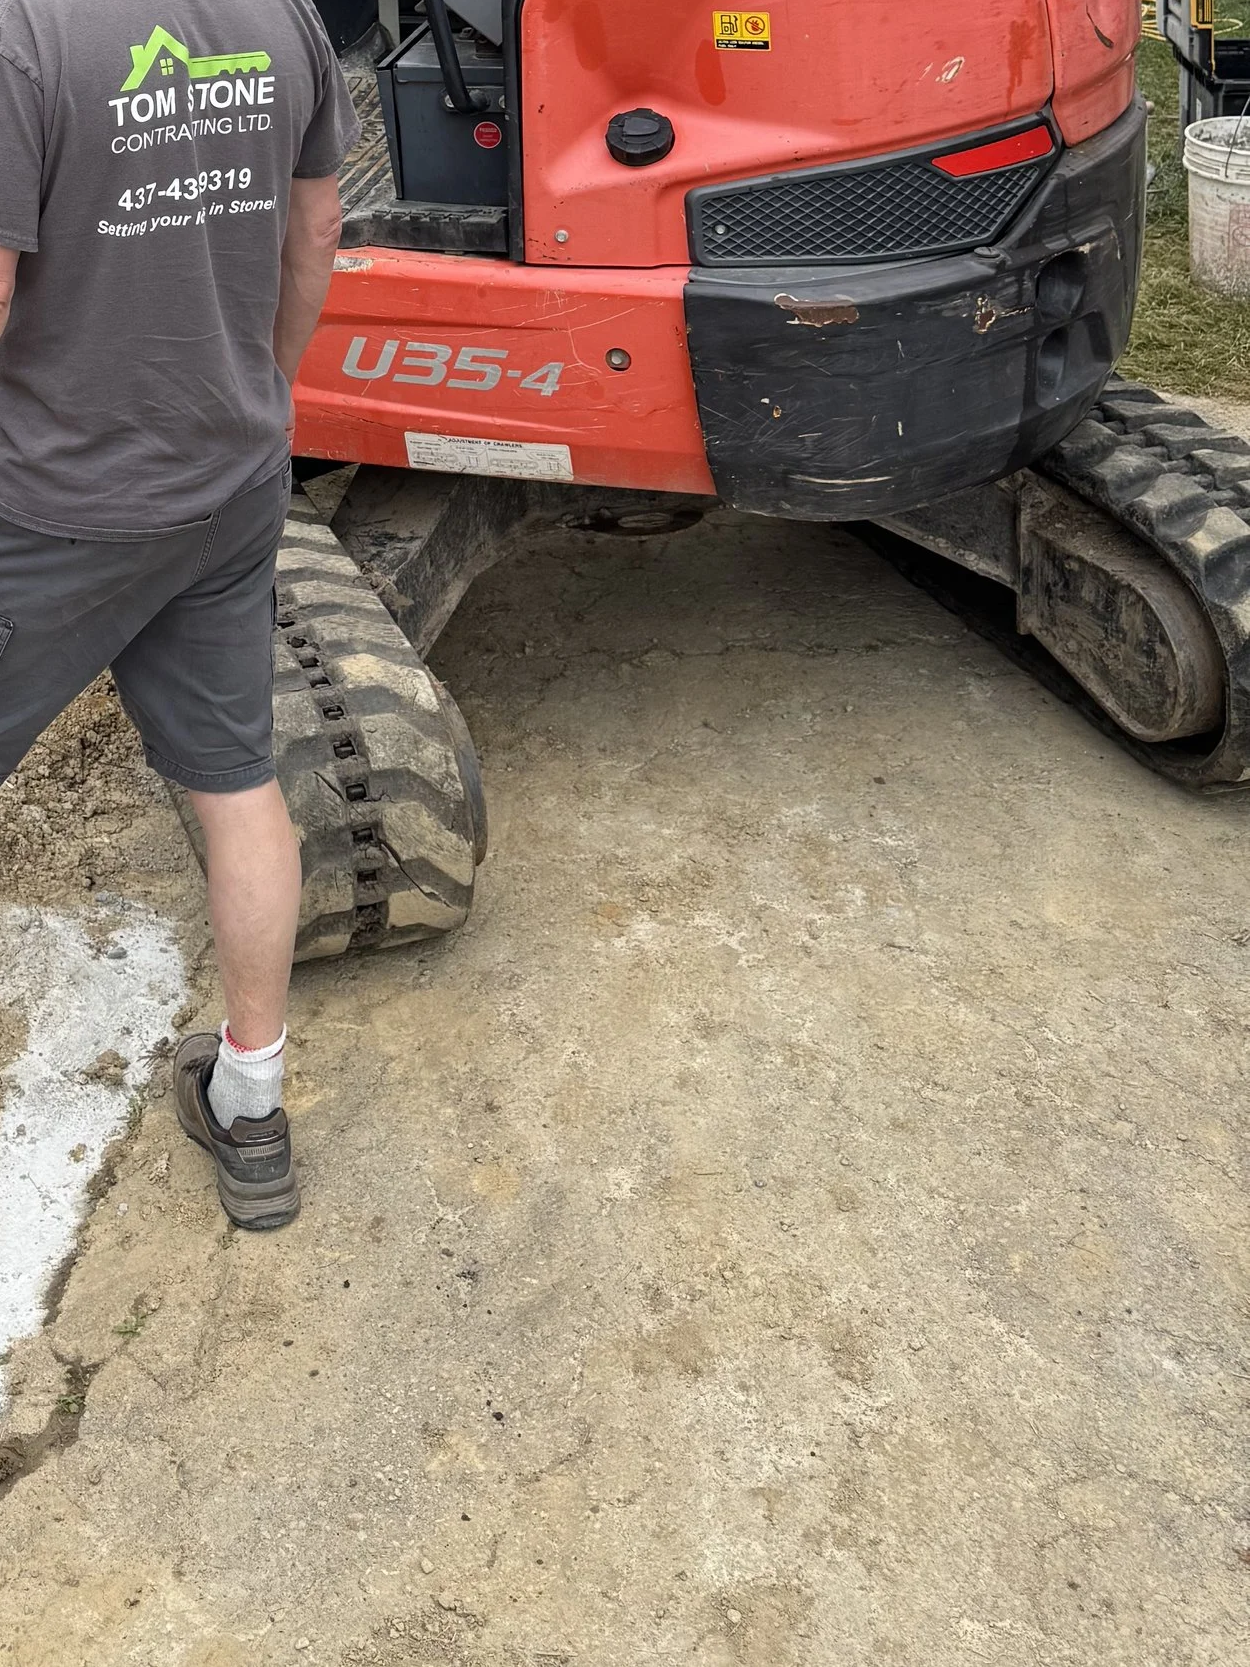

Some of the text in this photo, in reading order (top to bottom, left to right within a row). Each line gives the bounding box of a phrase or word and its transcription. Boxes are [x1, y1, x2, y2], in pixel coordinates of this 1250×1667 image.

[108, 76, 275, 127] TOM STONE
[111, 114, 273, 154] CONTRATING LTD.
[97, 220, 147, 237] Setting
[150, 215, 191, 232] your
[209, 202, 224, 216] in
[341, 337, 564, 396] U35-4
